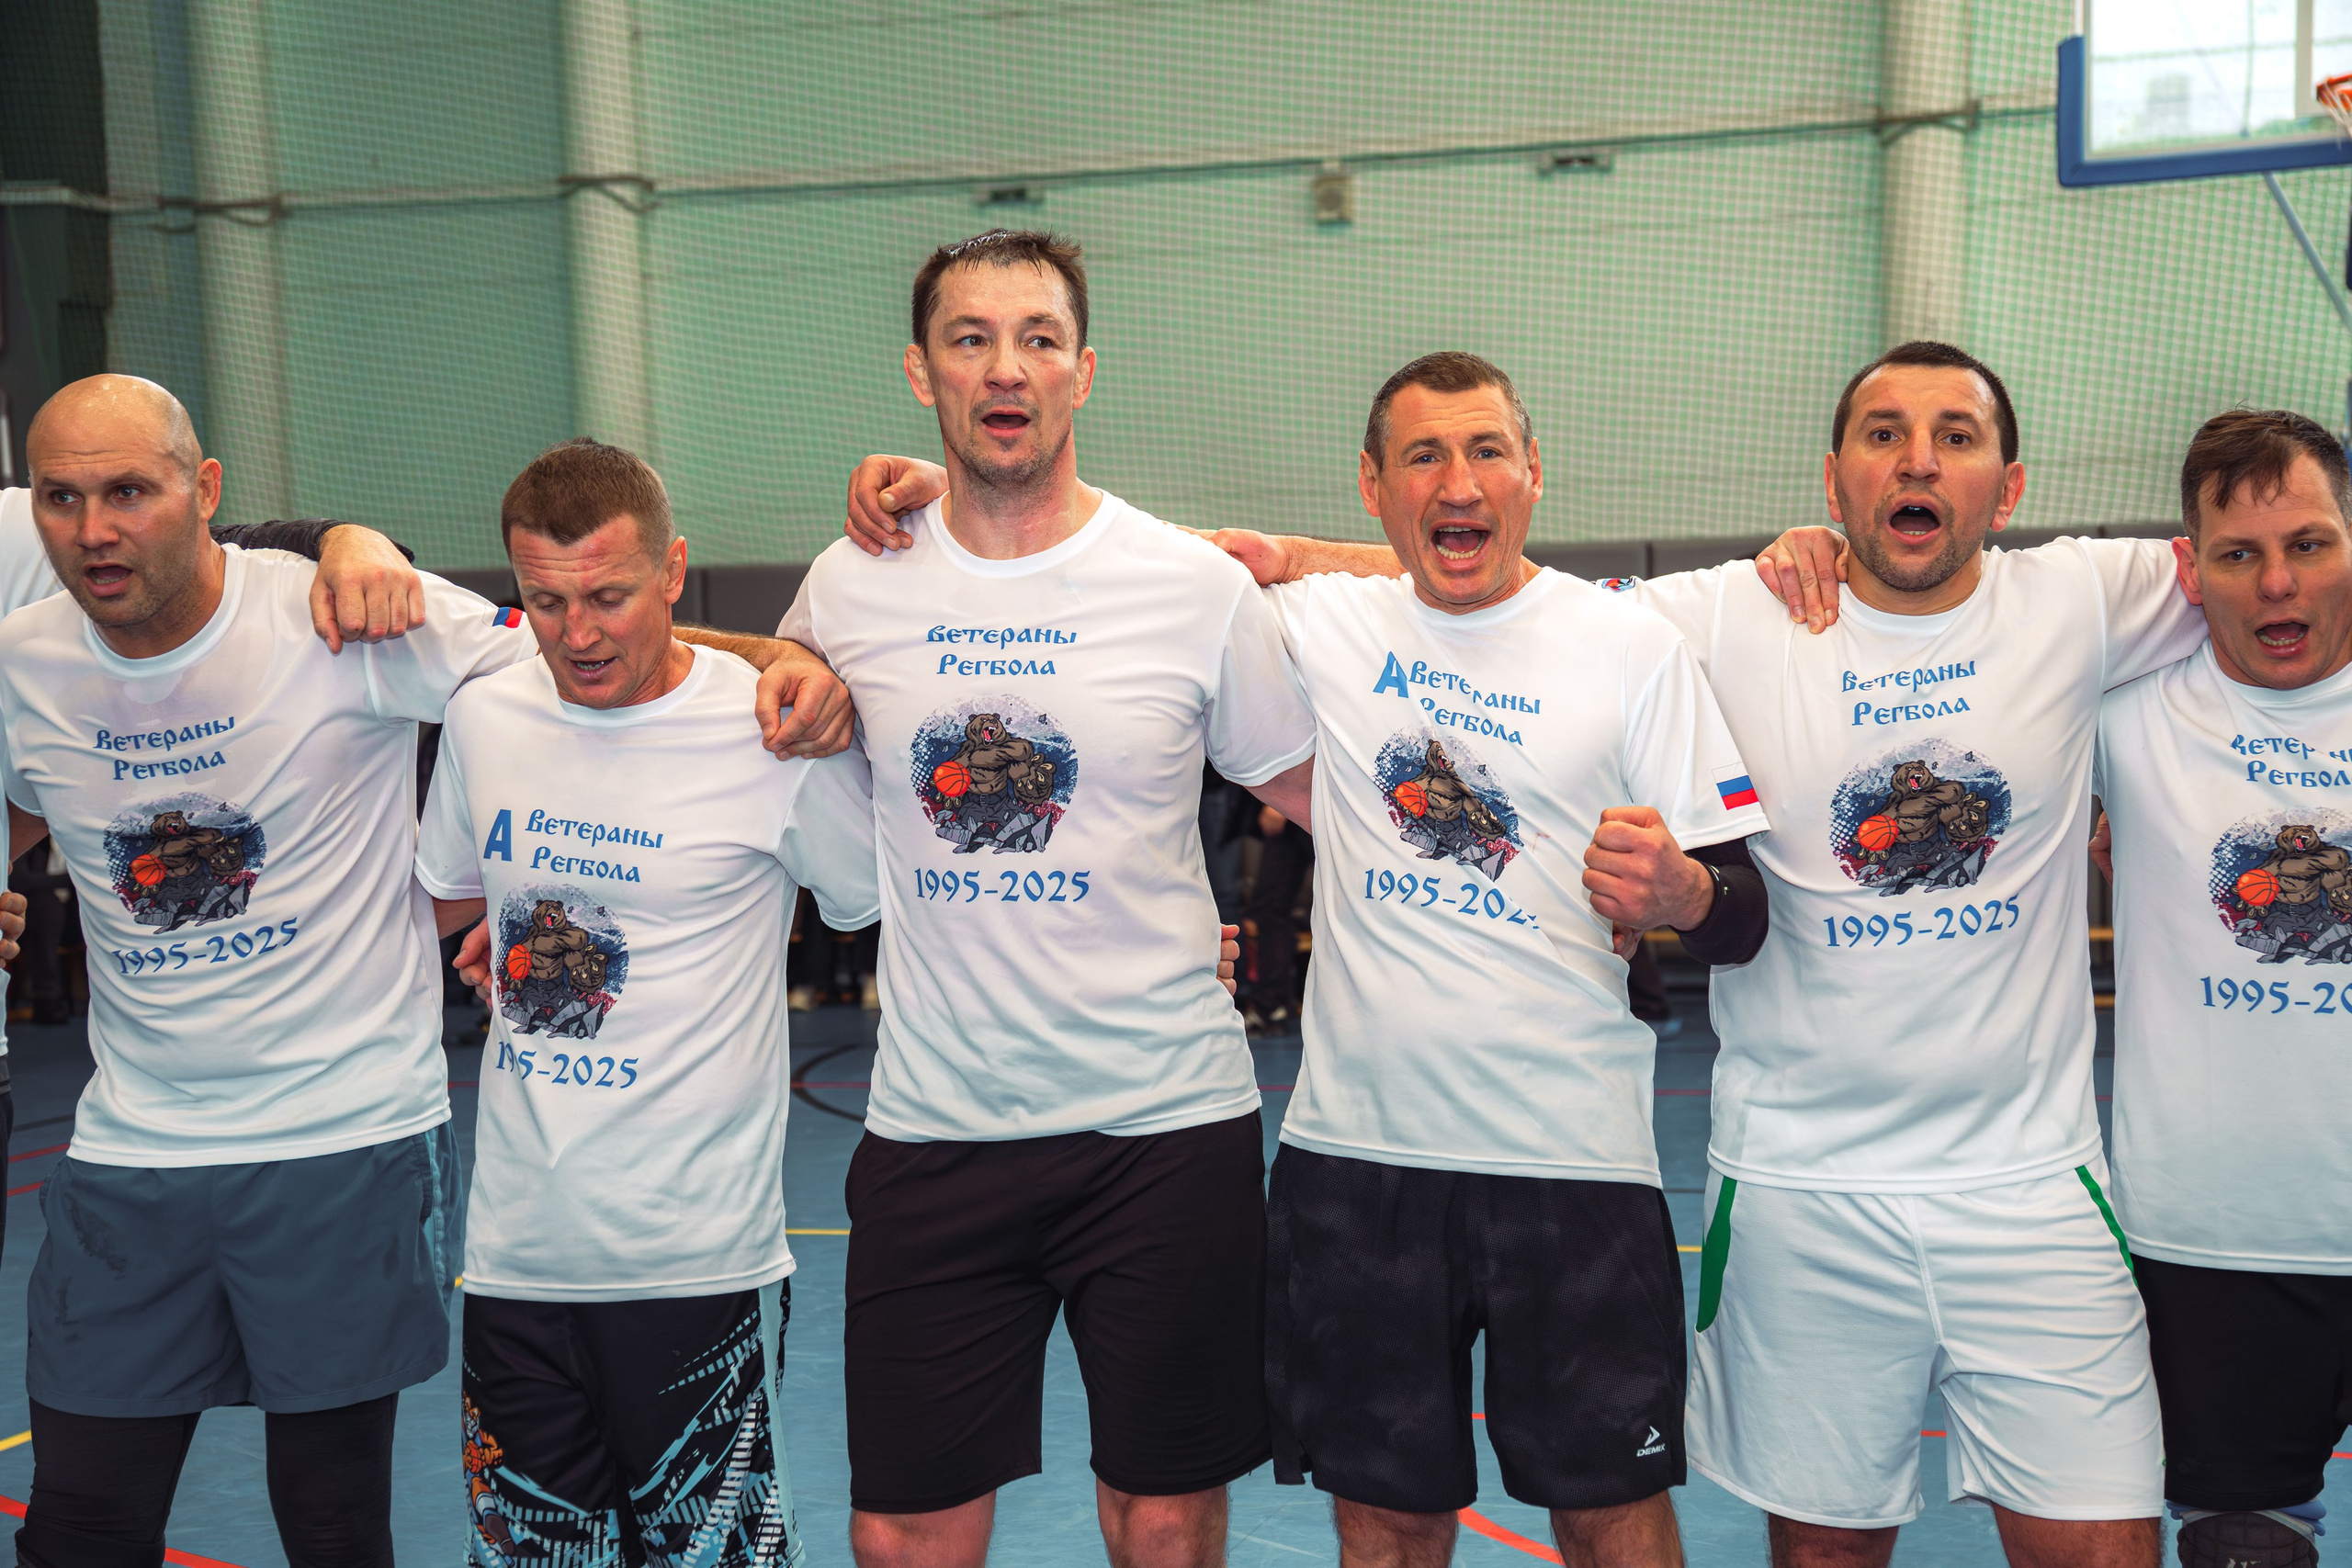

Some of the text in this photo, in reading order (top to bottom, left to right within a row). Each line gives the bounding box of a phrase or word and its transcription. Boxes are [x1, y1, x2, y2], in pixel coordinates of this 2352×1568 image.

[914, 868, 1091, 903] 1995-2025
[1823, 895, 2019, 948] 1995-2025
[112, 917, 298, 975] 1995-2025
[1636, 1443, 1666, 1457] DEMIX
